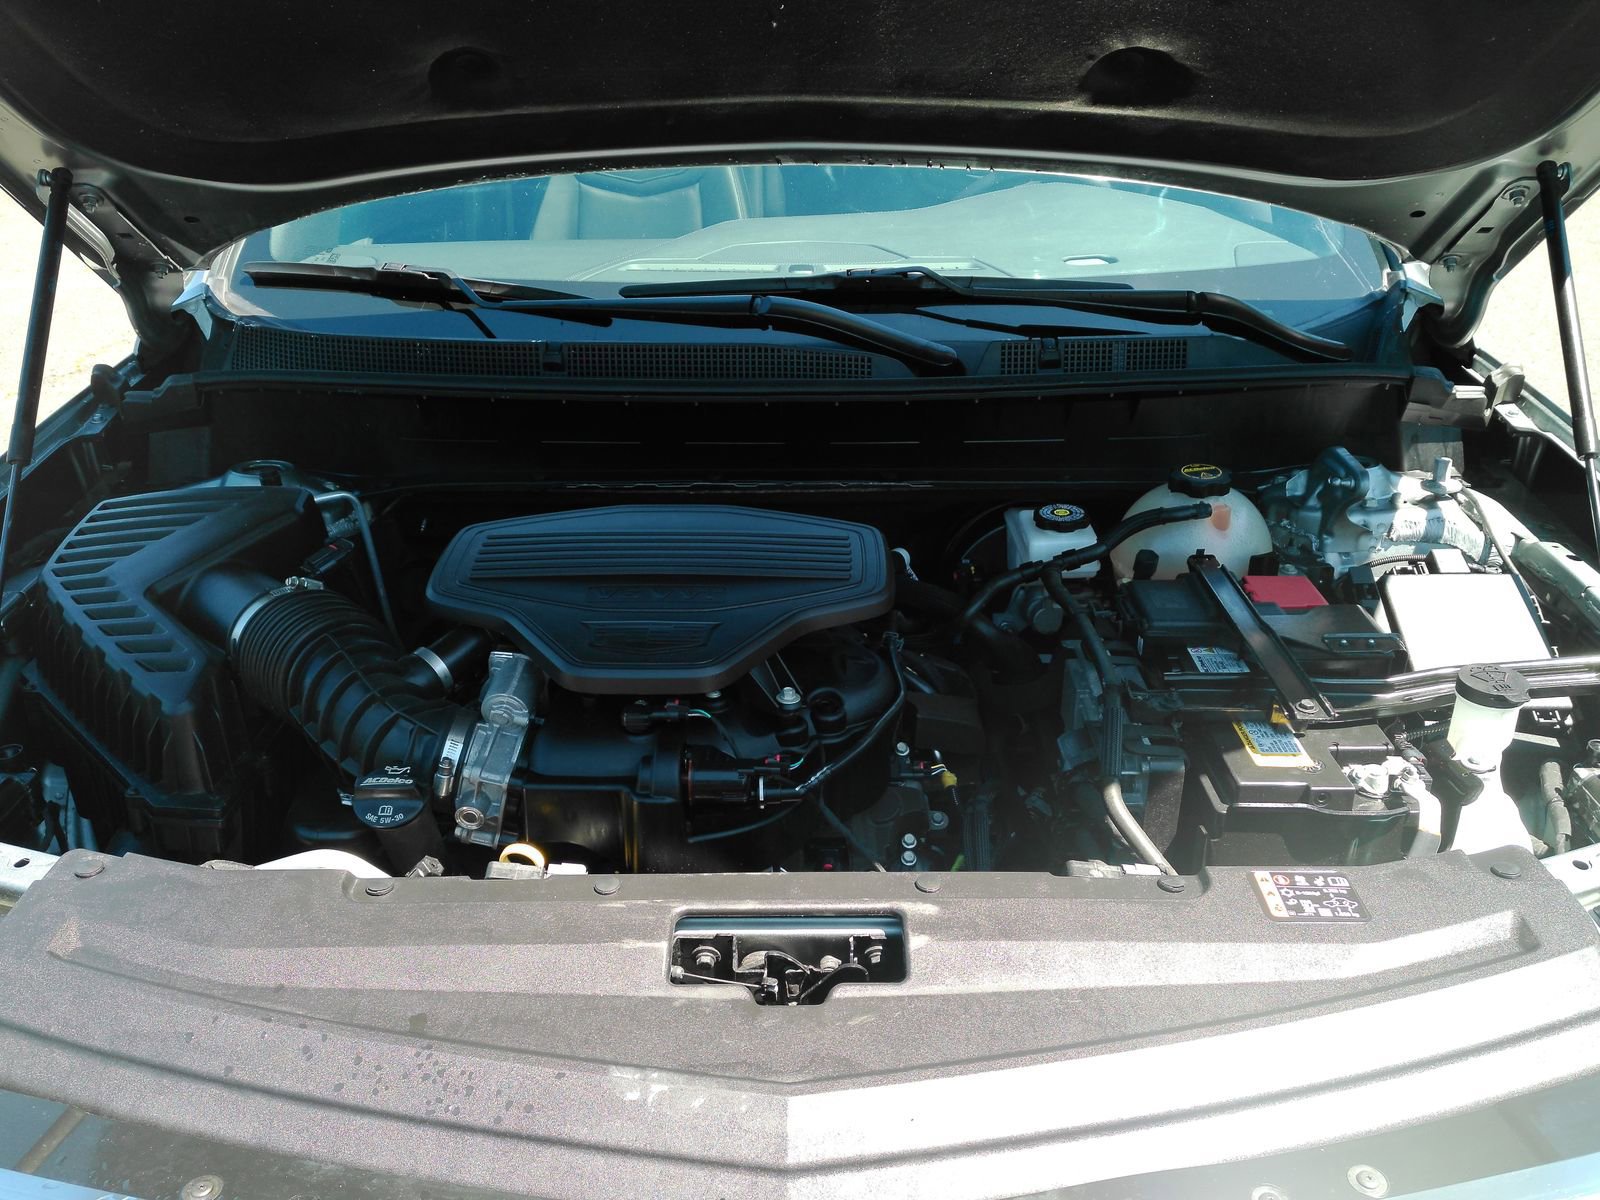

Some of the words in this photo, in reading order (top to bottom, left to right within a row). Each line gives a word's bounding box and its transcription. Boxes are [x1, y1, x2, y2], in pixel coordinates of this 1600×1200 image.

[360, 777, 413, 785] ACDelco
[365, 813, 378, 823] SAE
[380, 813, 404, 824] 5W-30
